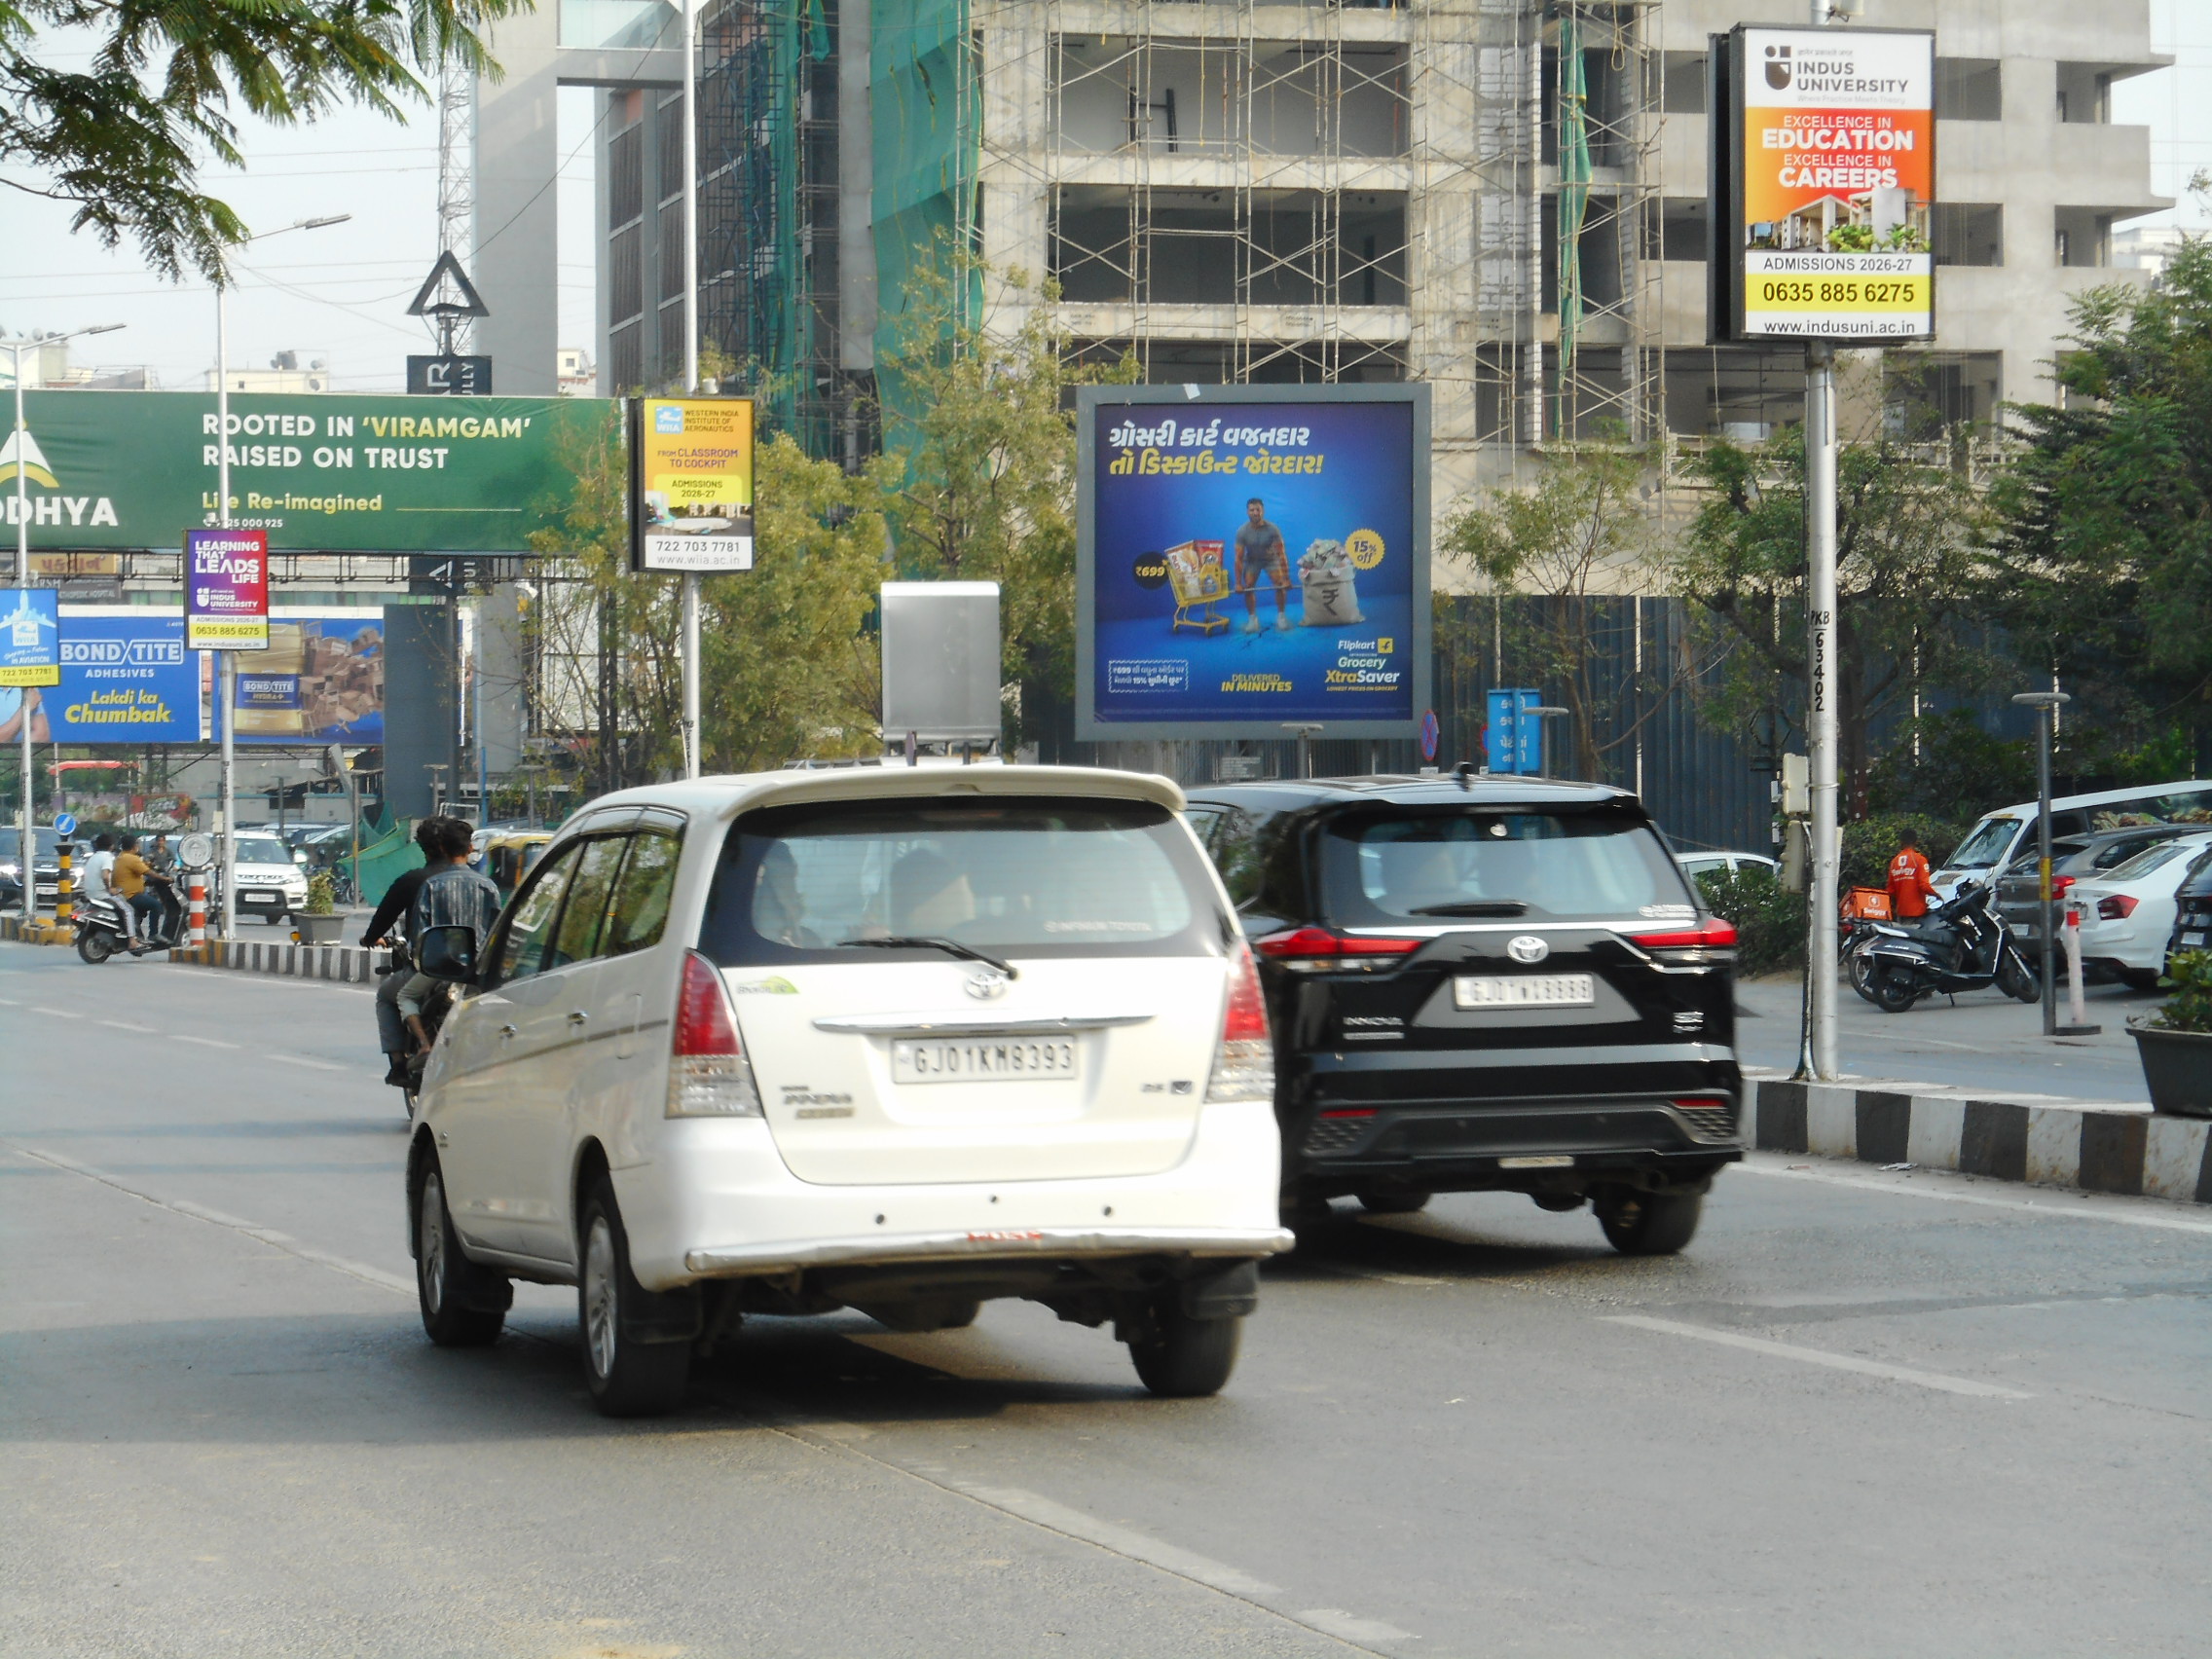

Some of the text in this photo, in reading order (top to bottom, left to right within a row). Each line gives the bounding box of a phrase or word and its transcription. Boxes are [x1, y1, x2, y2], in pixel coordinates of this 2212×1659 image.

[1797, 61, 1855, 75] INDUS
[1797, 78, 1908, 92] UNIVERSITY
[1784, 115, 1892, 129] EXCELLENCE IN
[1762, 128, 1914, 151] EDUCATION
[1784, 154, 1892, 166] EXCELLENCE IN
[1778, 166, 1898, 189] CAREERS
[1763, 257, 1912, 272] ADMISSIONS 2026-27
[1763, 282, 1915, 303] 0635 885 6275
[1764, 320, 1916, 334] www.indusuni.ac.in
[203, 414, 315, 436] ROOTED
[327, 417, 353, 436] IN
[657, 424, 681, 432] WIIA
[1180, 419, 1221, 446] કાર્ટ
[1223, 426, 1309, 446] વજનદાર
[203, 445, 449, 469] RAISED ON TRUST
[678, 448, 738, 458] CLASSROOM
[670, 459, 682, 467] TO
[1110, 448, 1135, 475] તો
[1242, 448, 1323, 475] જોરદાર!
[202, 493, 383, 514] Lie Re-imagined
[0, 496, 119, 527] DHYA
[241, 518, 263, 527] 000
[195, 540, 260, 551] LEARNING
[656, 541, 740, 552] 722 703 7781
[195, 551, 226, 560] THAT
[657, 556, 740, 565] www.wiia.ac.in
[195, 559, 260, 573] LEADS
[232, 573, 259, 584] LIFE
[1338, 641, 1375, 651] Flipkart
[1338, 656, 1386, 670] Grocery
[85, 669, 155, 678] ADHESIVES
[1325, 670, 1400, 683] XtraSaver
[1221, 682, 1292, 692] IN MINUTES
[91, 689, 158, 704] Lakdi ka
[64, 703, 171, 723] Chumbak
[914, 1044, 1072, 1073] GJ01KM8393
